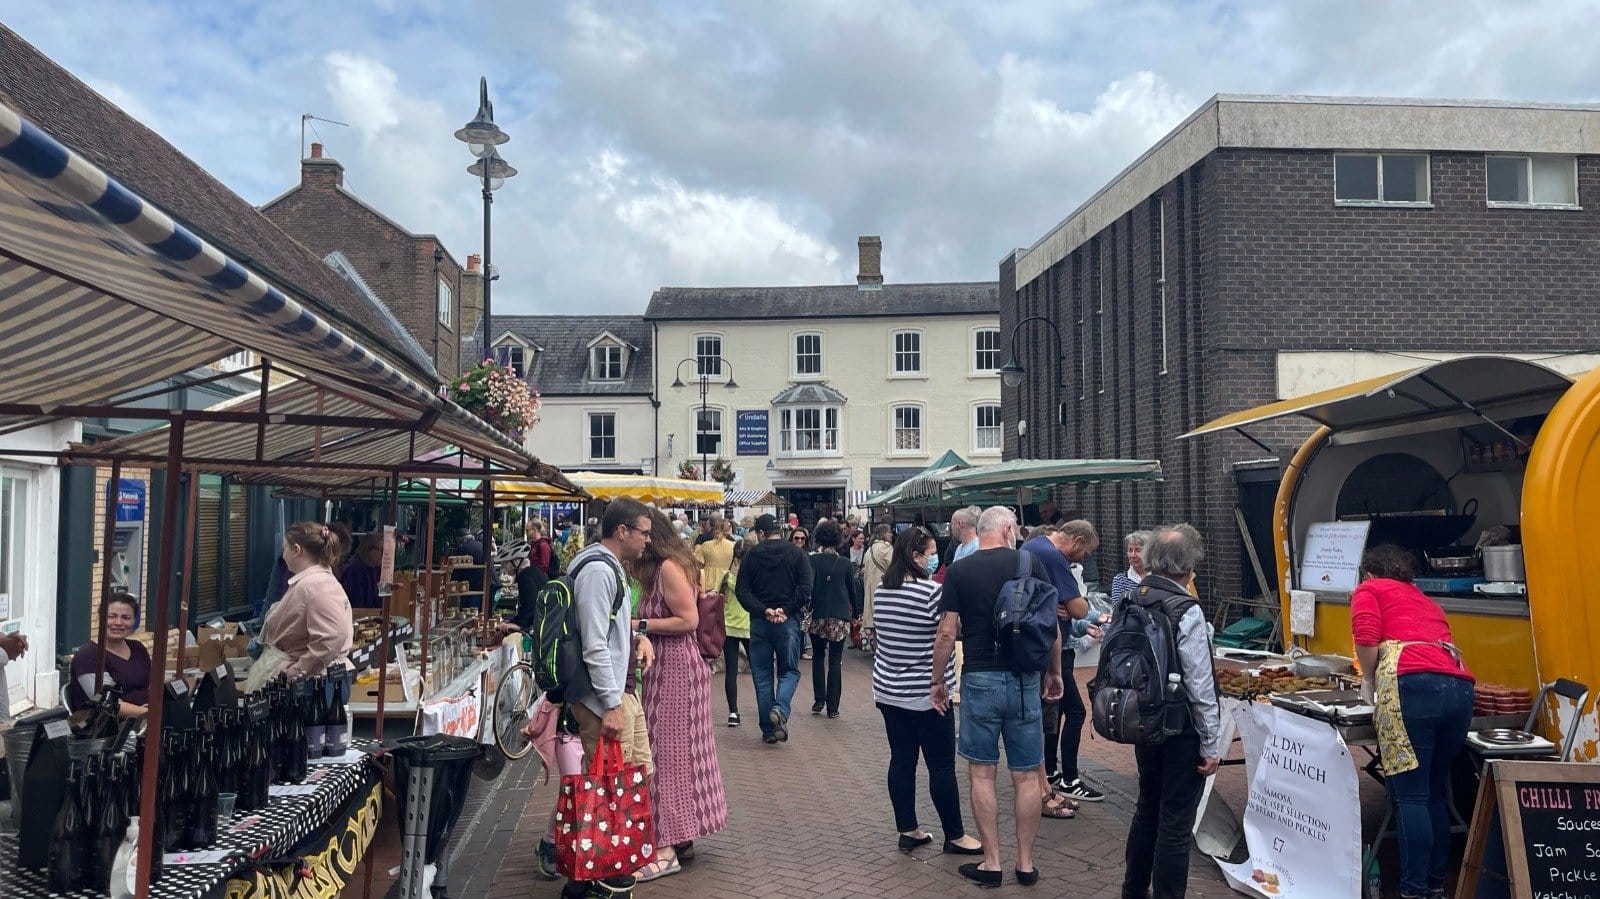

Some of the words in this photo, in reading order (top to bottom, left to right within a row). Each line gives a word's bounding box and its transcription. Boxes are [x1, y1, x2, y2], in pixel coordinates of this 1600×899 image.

[1281, 737, 1305, 756] DAY
[1283, 756, 1326, 784] LUNCH
[1520, 788, 1572, 809] CHILLI
[1255, 804, 1276, 820] BREAD
[1278, 814, 1294, 828] AND
[1295, 822, 1327, 842] PICKLES
[1286, 806, 1332, 833] SELECTION)
[1273, 836, 1285, 852] £7
[1533, 843, 1567, 858] Jam
[1549, 867, 1598, 882] Pickle
